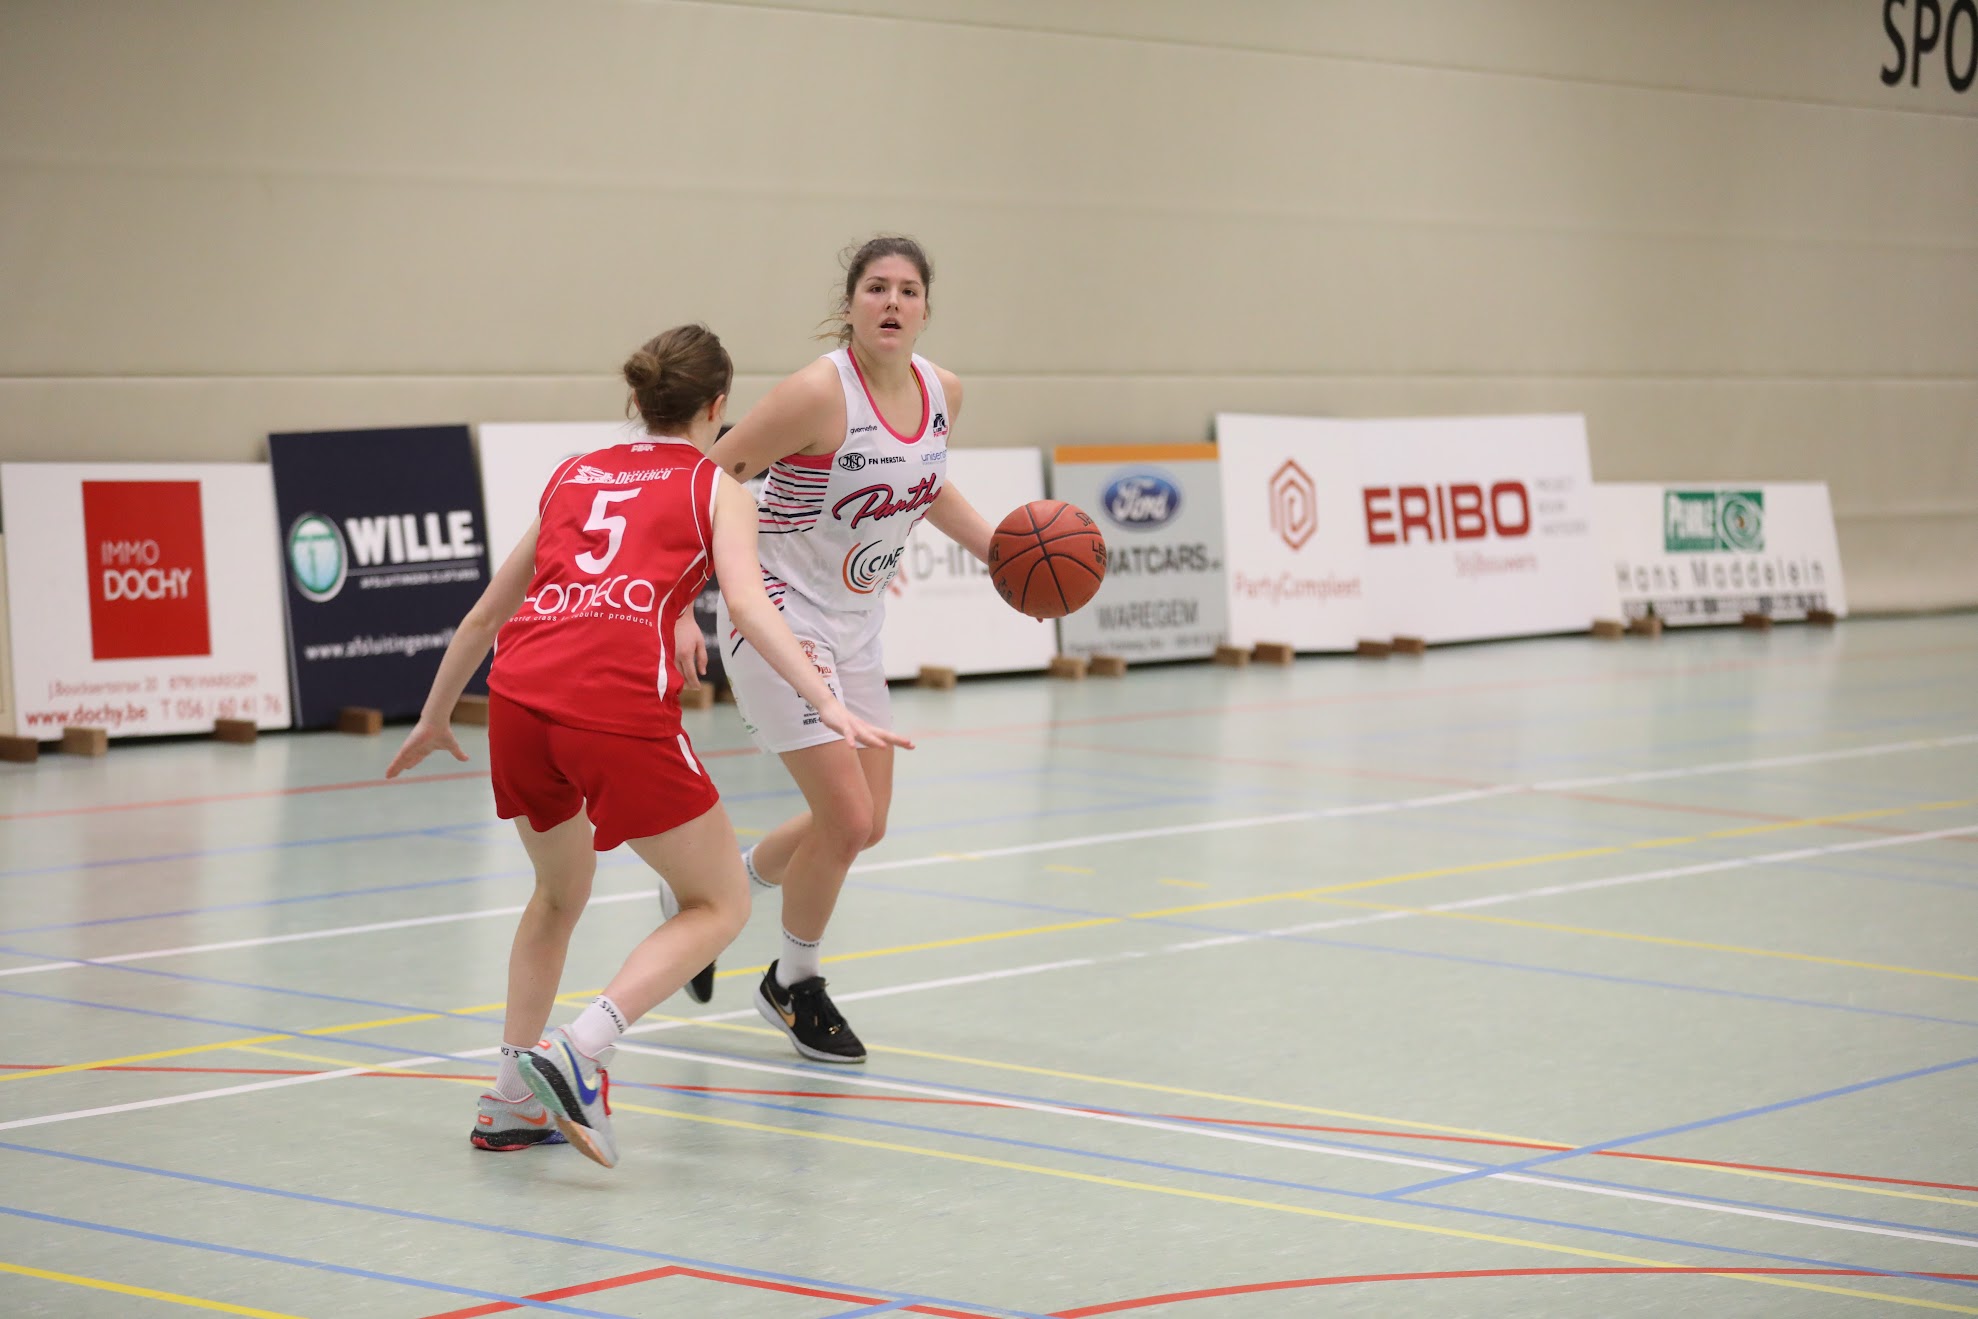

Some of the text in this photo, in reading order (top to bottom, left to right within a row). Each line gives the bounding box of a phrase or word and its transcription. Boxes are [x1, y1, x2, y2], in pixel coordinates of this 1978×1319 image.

[1880, 0, 1978, 93] SPO
[880, 456, 906, 464] HERSTAL
[1112, 479, 1169, 521] Ford
[1363, 481, 1530, 544] ERIBO
[345, 510, 475, 566] WILLE
[575, 487, 642, 574] 5
[101, 540, 160, 566] IMMO
[103, 569, 192, 600] DOCHY
[608, 612, 653, 627] products
[26, 703, 147, 727] www.dochy.be
